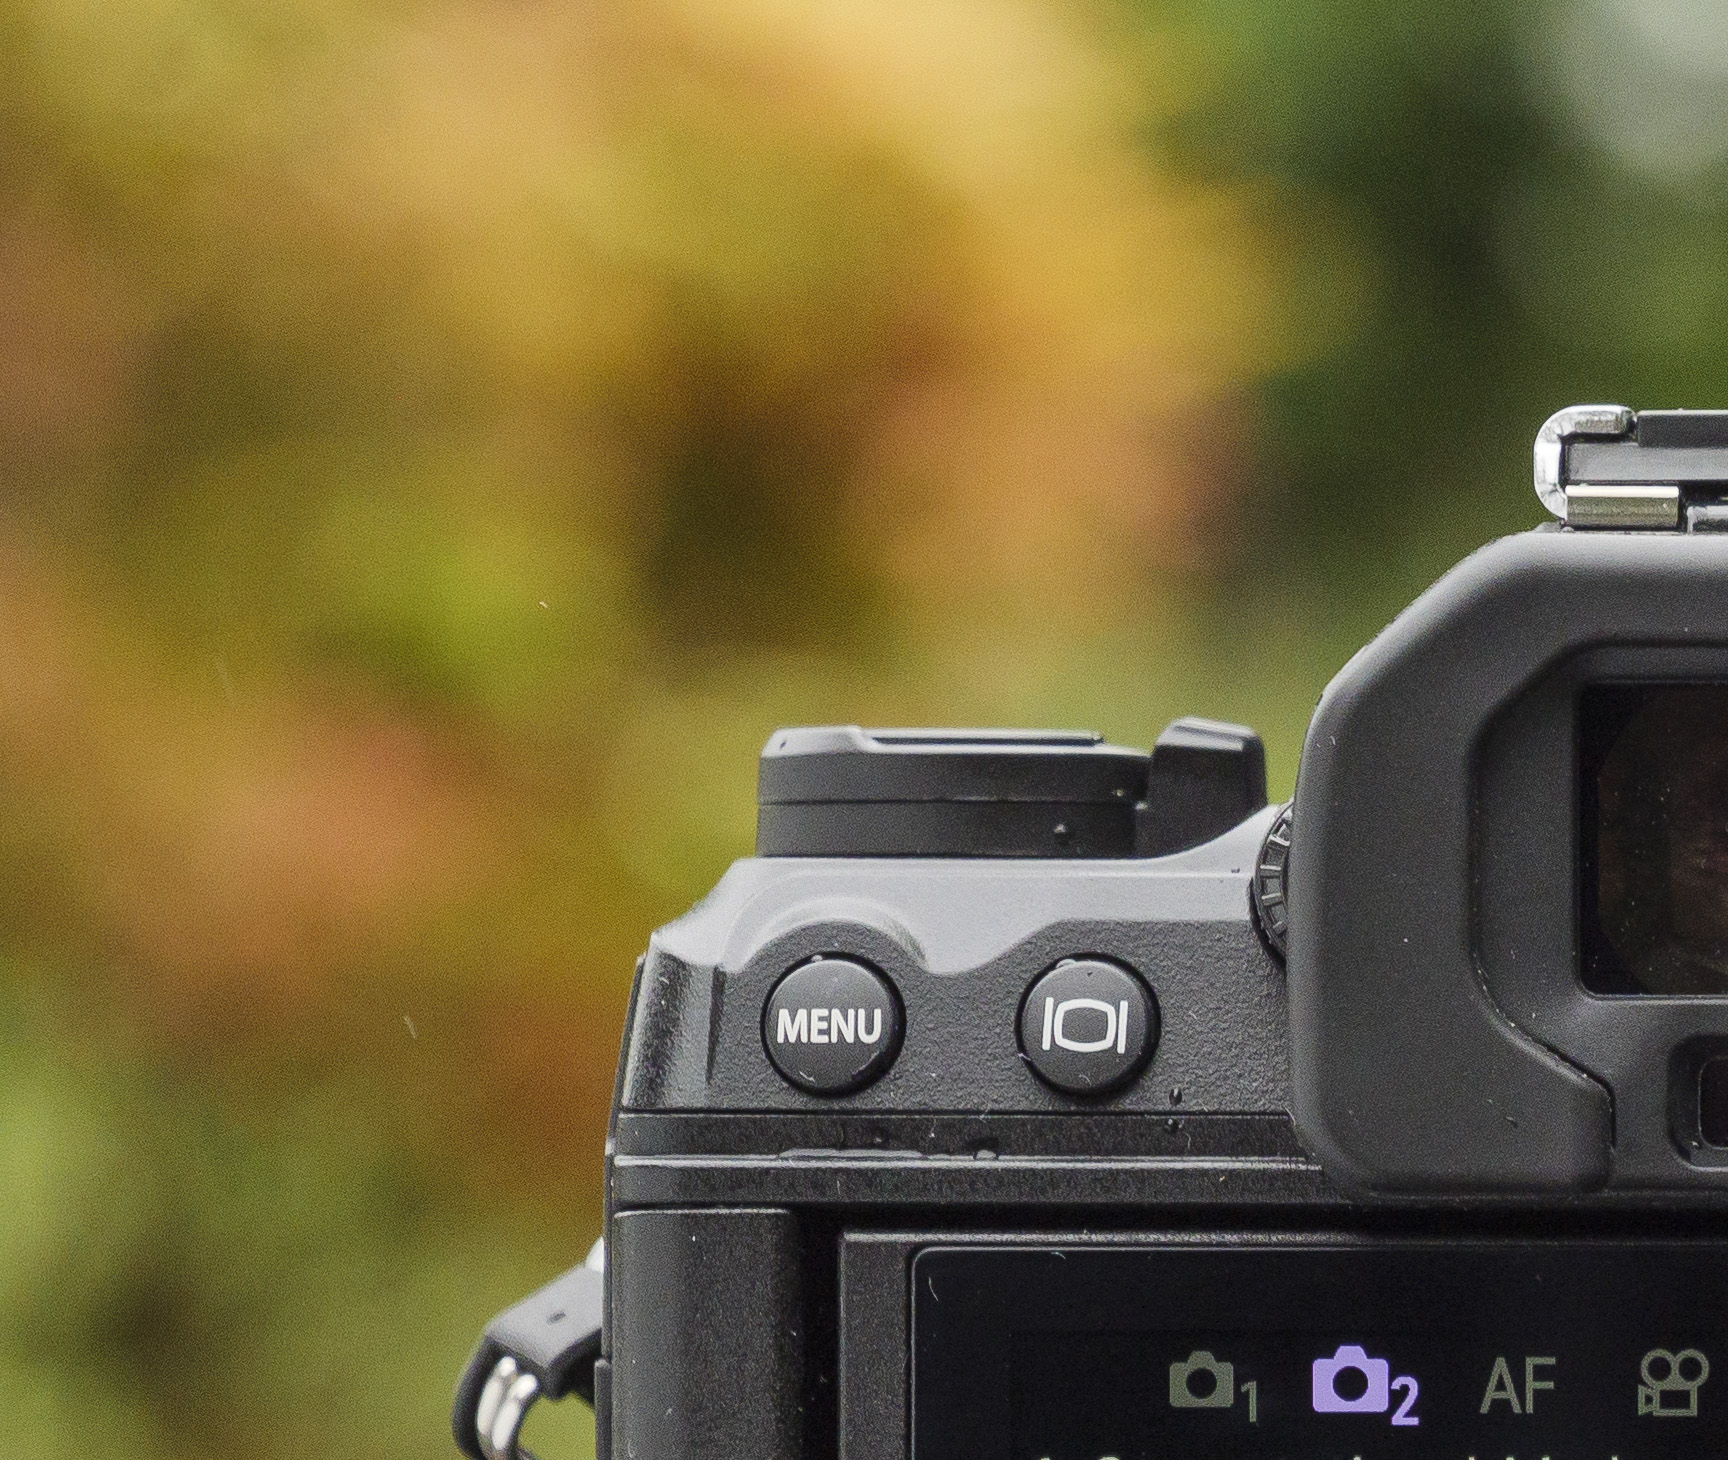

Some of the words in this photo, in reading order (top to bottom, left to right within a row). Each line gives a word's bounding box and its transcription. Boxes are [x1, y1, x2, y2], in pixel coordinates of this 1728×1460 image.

[776, 1007, 883, 1044] MENU
[1390, 1375, 1420, 1426] 2
[1479, 1356, 1557, 1414] AF
